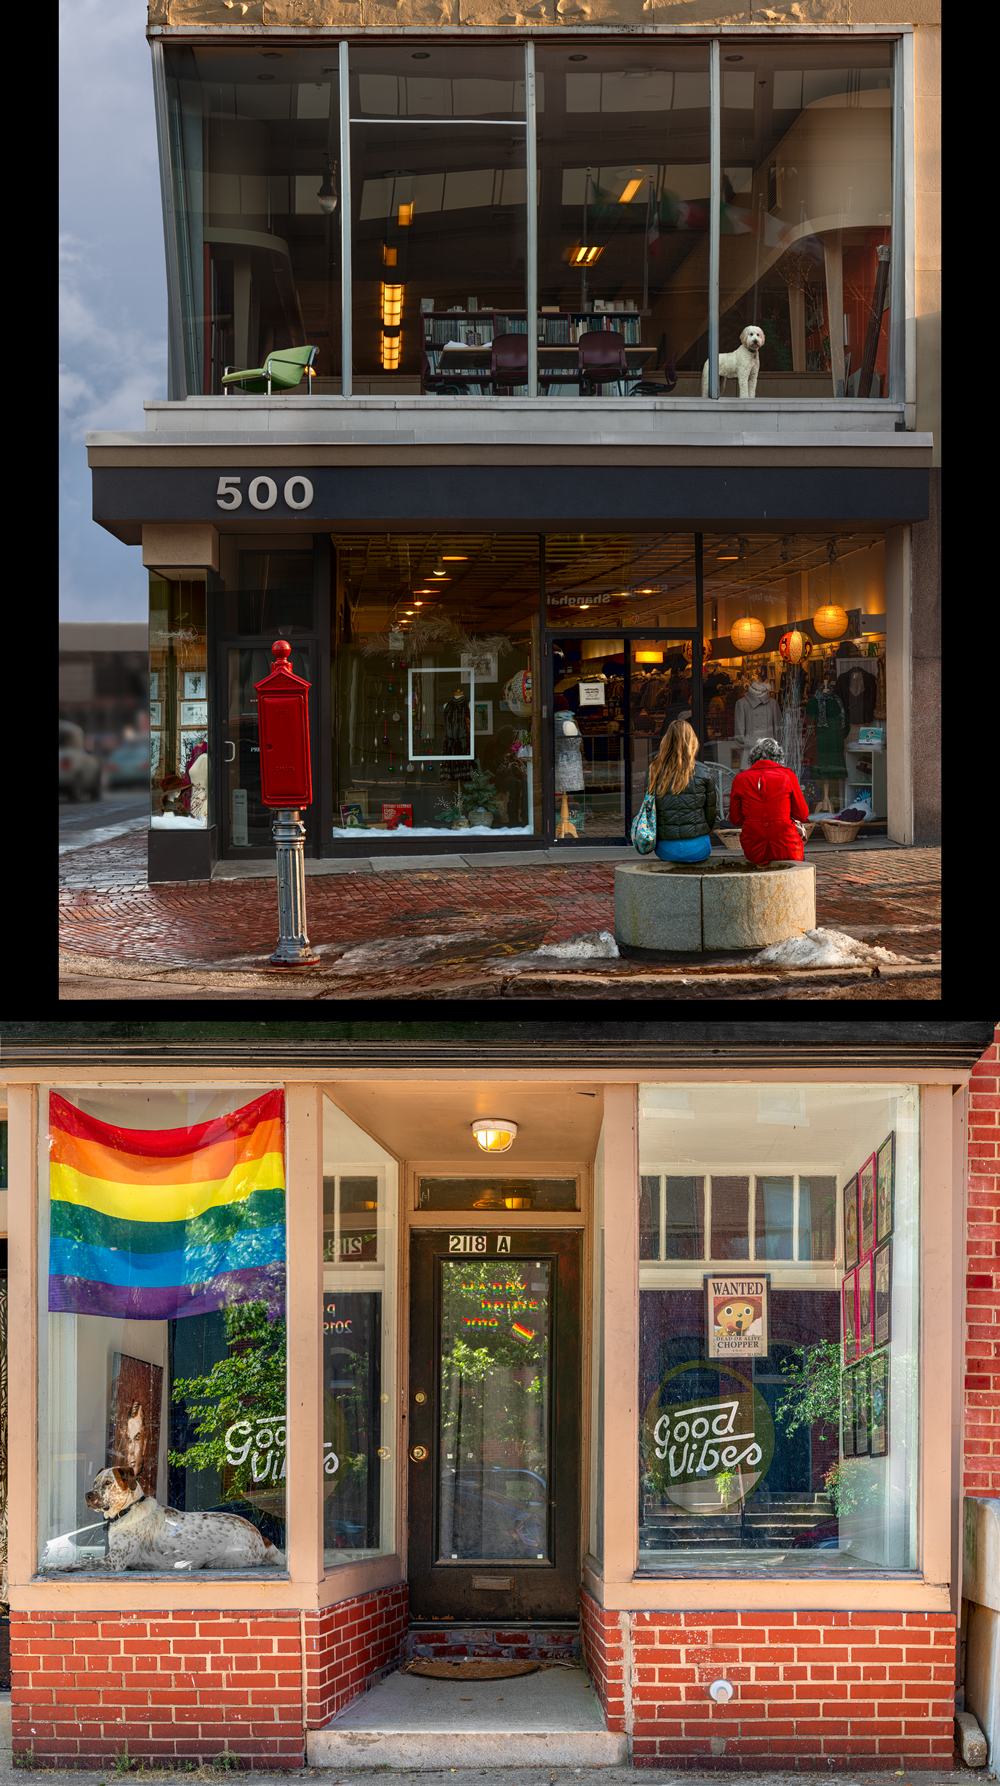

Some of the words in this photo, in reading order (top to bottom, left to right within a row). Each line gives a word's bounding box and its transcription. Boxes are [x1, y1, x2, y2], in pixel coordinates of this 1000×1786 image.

[216, 475, 315, 511] 500
[450, 1236, 485, 1252] 2118
[497, 1236, 509, 1252] A
[462, 1282, 528, 1296] HAPPY
[712, 1282, 764, 1296] WANTED
[481, 1301, 539, 1315] PRIDE
[461, 1318, 499, 1332] 2019
[717, 1341, 760, 1349] CHOPPER
[653, 1401, 740, 1460] Good
[224, 1415, 288, 1466] Goo
[251, 1442, 339, 1483] Vis
[668, 1432, 763, 1478] Vibes
